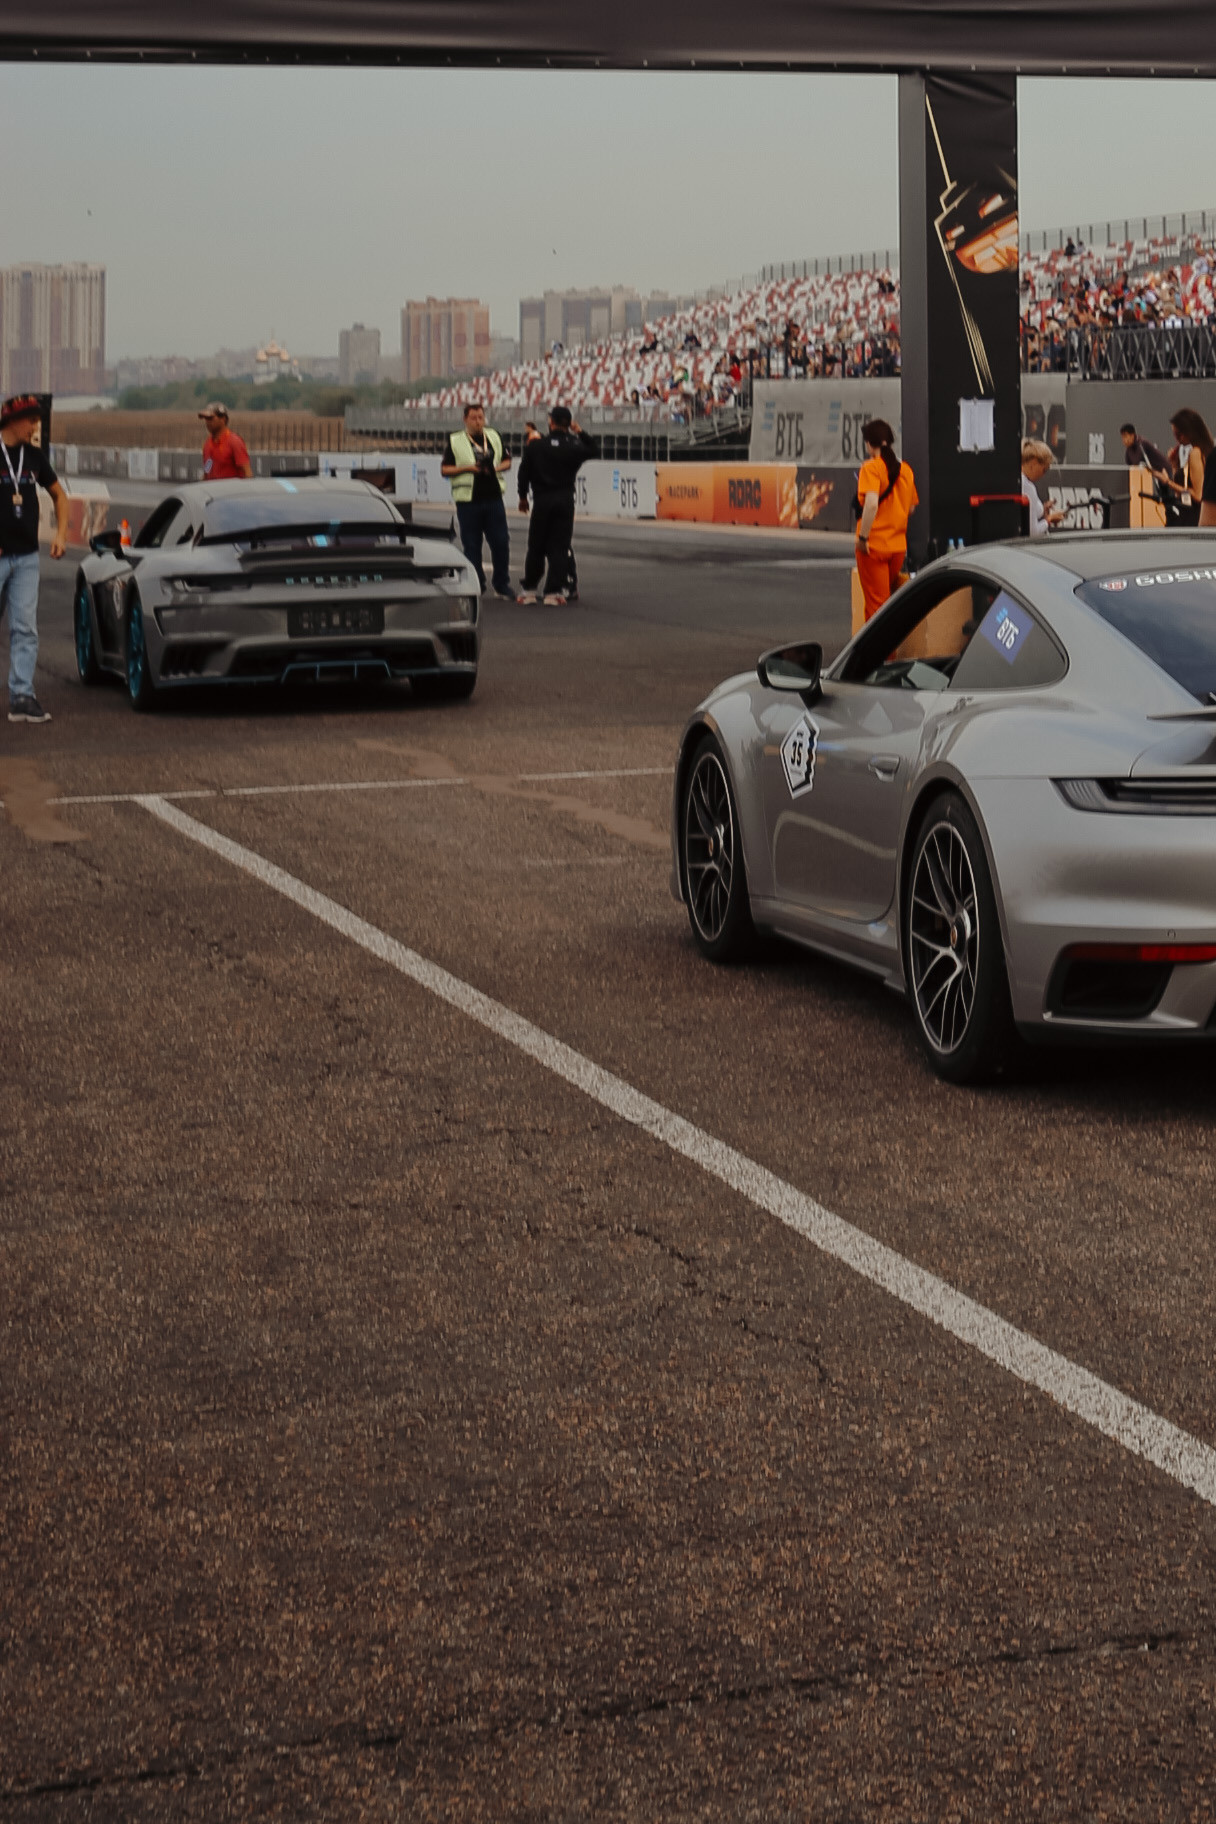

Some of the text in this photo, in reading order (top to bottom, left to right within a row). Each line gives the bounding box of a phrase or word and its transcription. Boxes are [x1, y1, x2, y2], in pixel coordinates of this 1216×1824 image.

[620, 478, 638, 508] ВТБ
[728, 478, 762, 510] RDRC
[996, 616, 1020, 650] ВТБ
